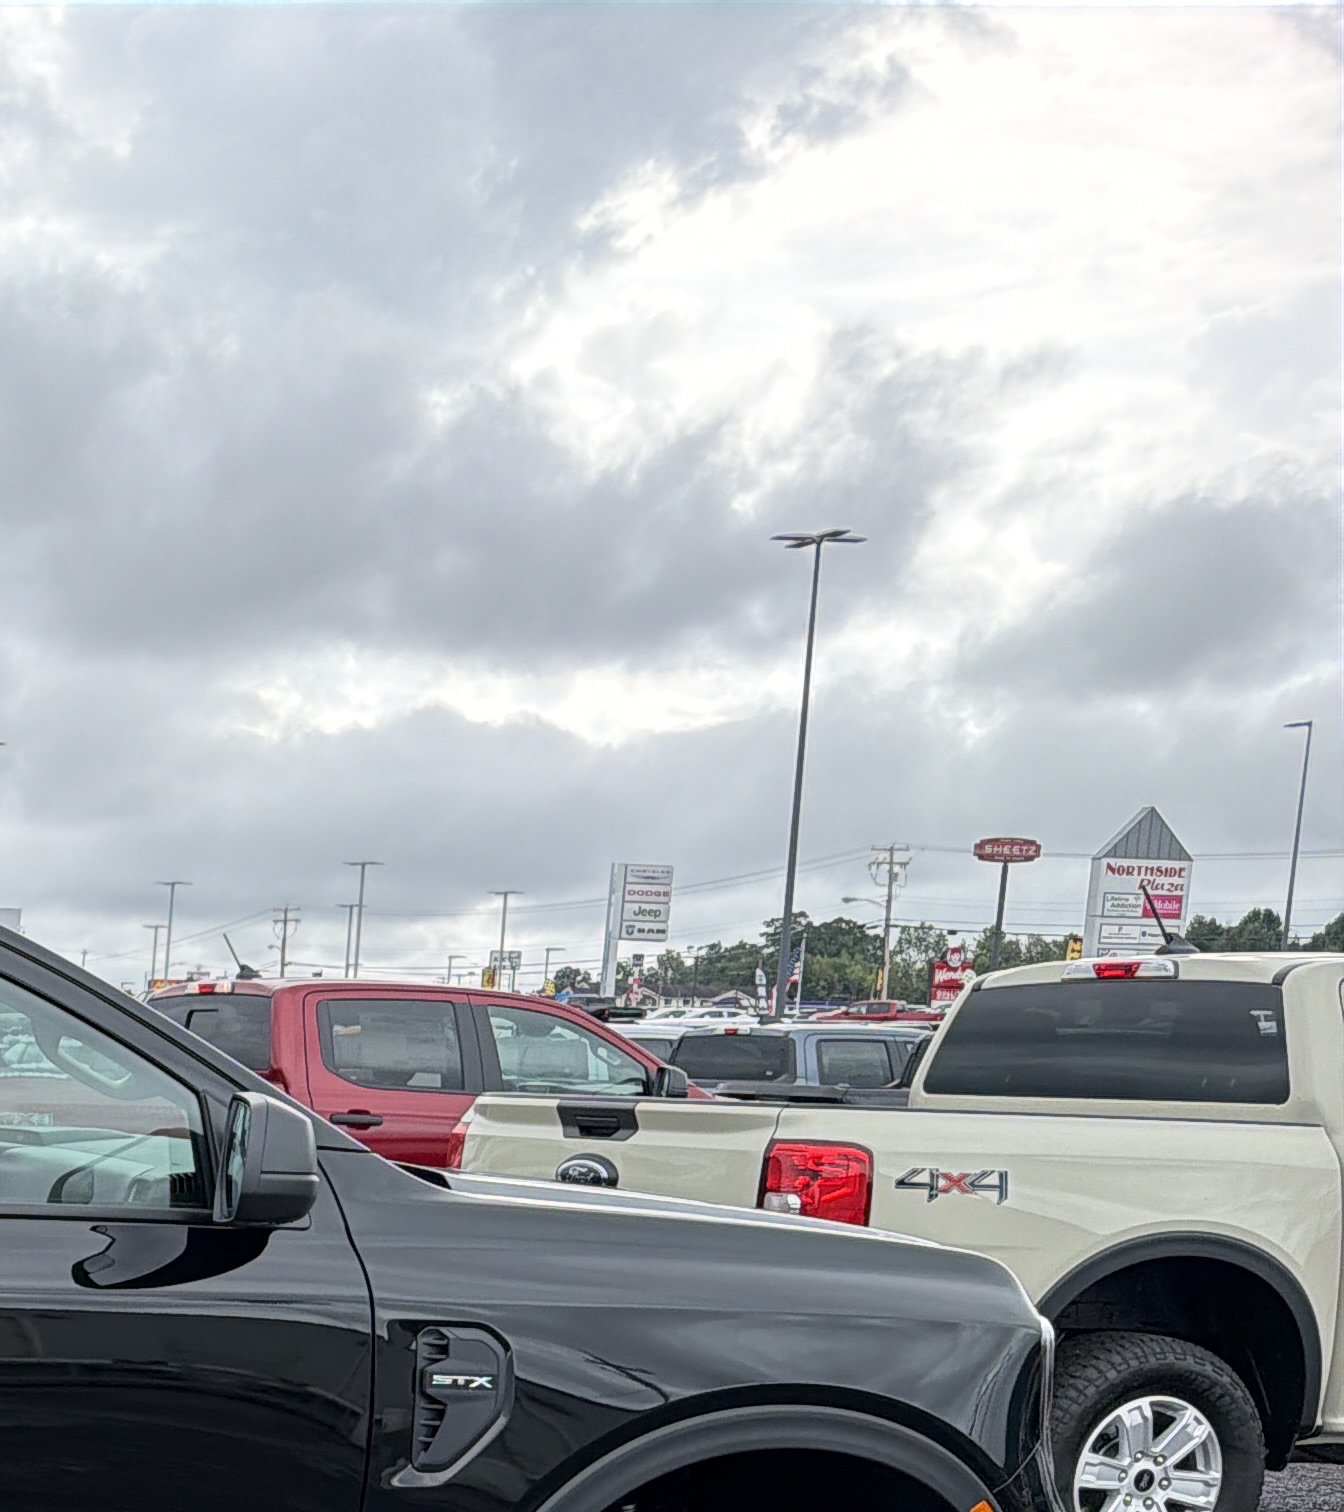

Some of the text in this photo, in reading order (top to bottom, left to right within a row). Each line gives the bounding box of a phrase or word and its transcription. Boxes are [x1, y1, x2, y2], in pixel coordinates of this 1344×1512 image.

[984, 844, 1037, 855] SHEETZ
[1106, 862, 1186, 878] NORTHSIDE
[1138, 878, 1185, 892] Plaza
[627, 889, 670, 898] DODGE
[632, 905, 662, 919] Jeep
[431, 1374, 493, 1388] STX
